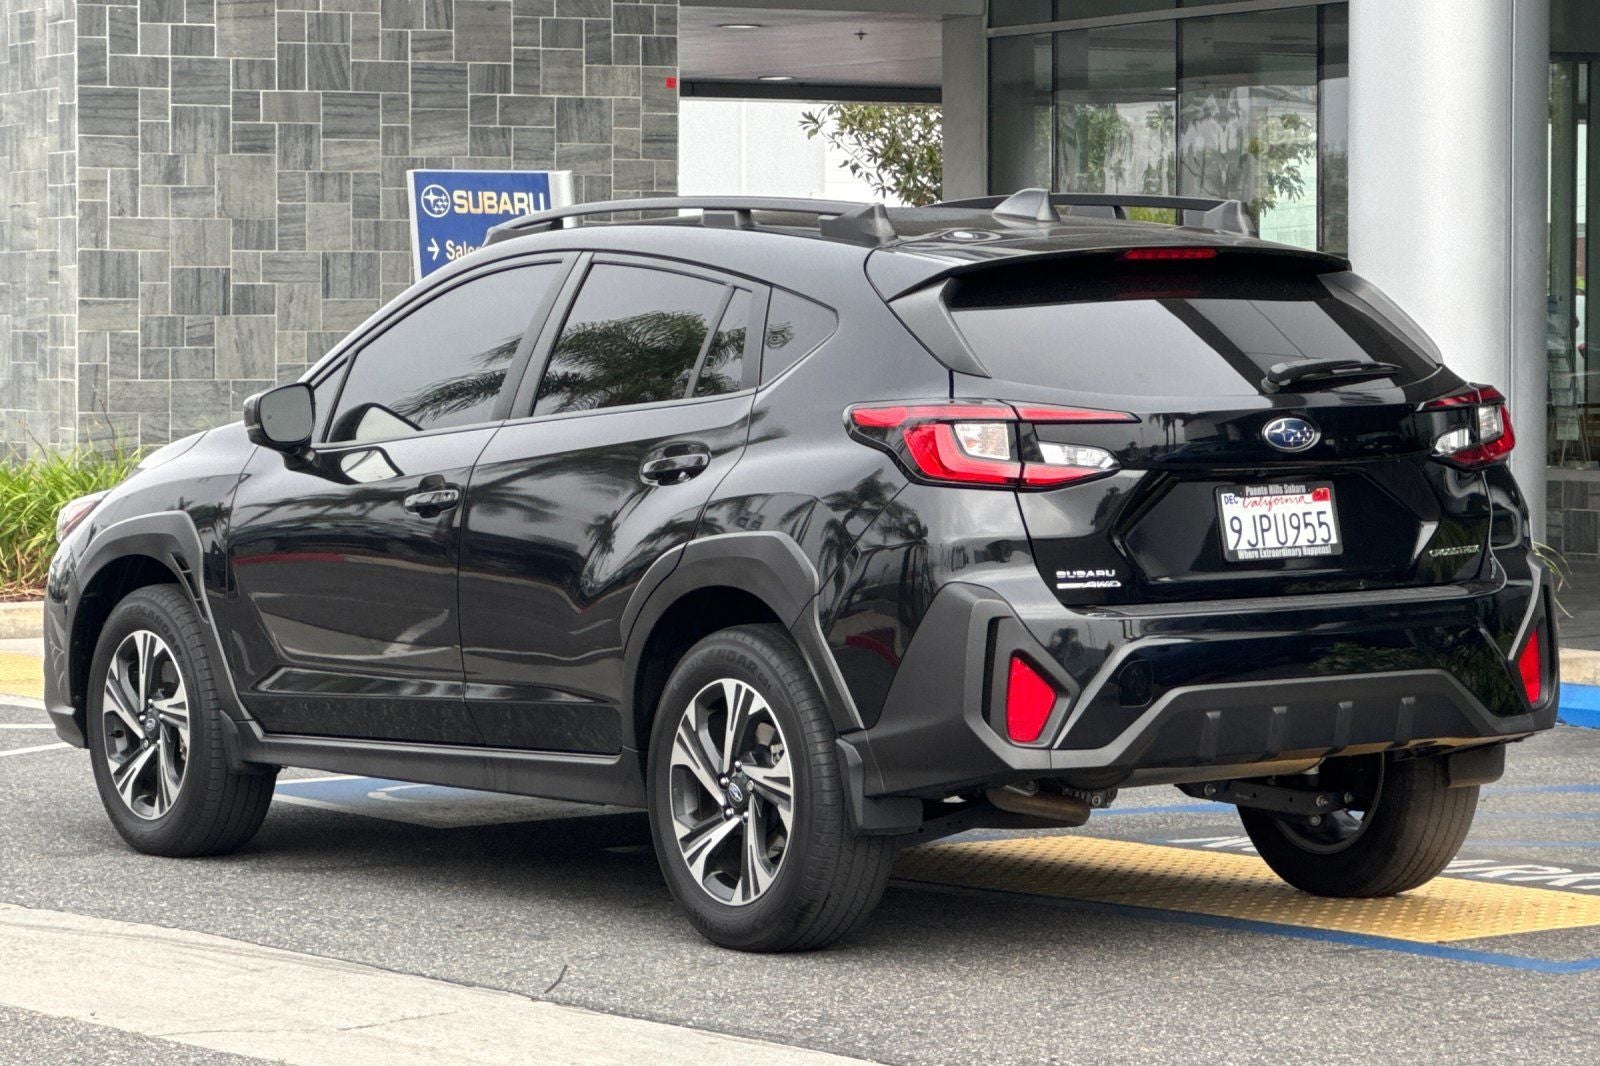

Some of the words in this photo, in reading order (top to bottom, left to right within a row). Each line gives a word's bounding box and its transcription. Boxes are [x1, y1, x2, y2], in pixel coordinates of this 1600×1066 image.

[452, 190, 545, 215] SUBARU
[1245, 485, 1268, 496] Puente
[1269, 484, 1283, 495] Hills
[1284, 483, 1306, 494] Subaru
[1223, 495, 1239, 505] DEC
[1242, 494, 1312, 512] California
[1229, 510, 1332, 550] 9JPU955
[1237, 548, 1259, 560] Where
[1260, 546, 1301, 558] Extraordinary
[1302, 545, 1332, 556] Happens!
[1056, 569, 1116, 578] SUBARU
[1084, 580, 1121, 588] AWD
